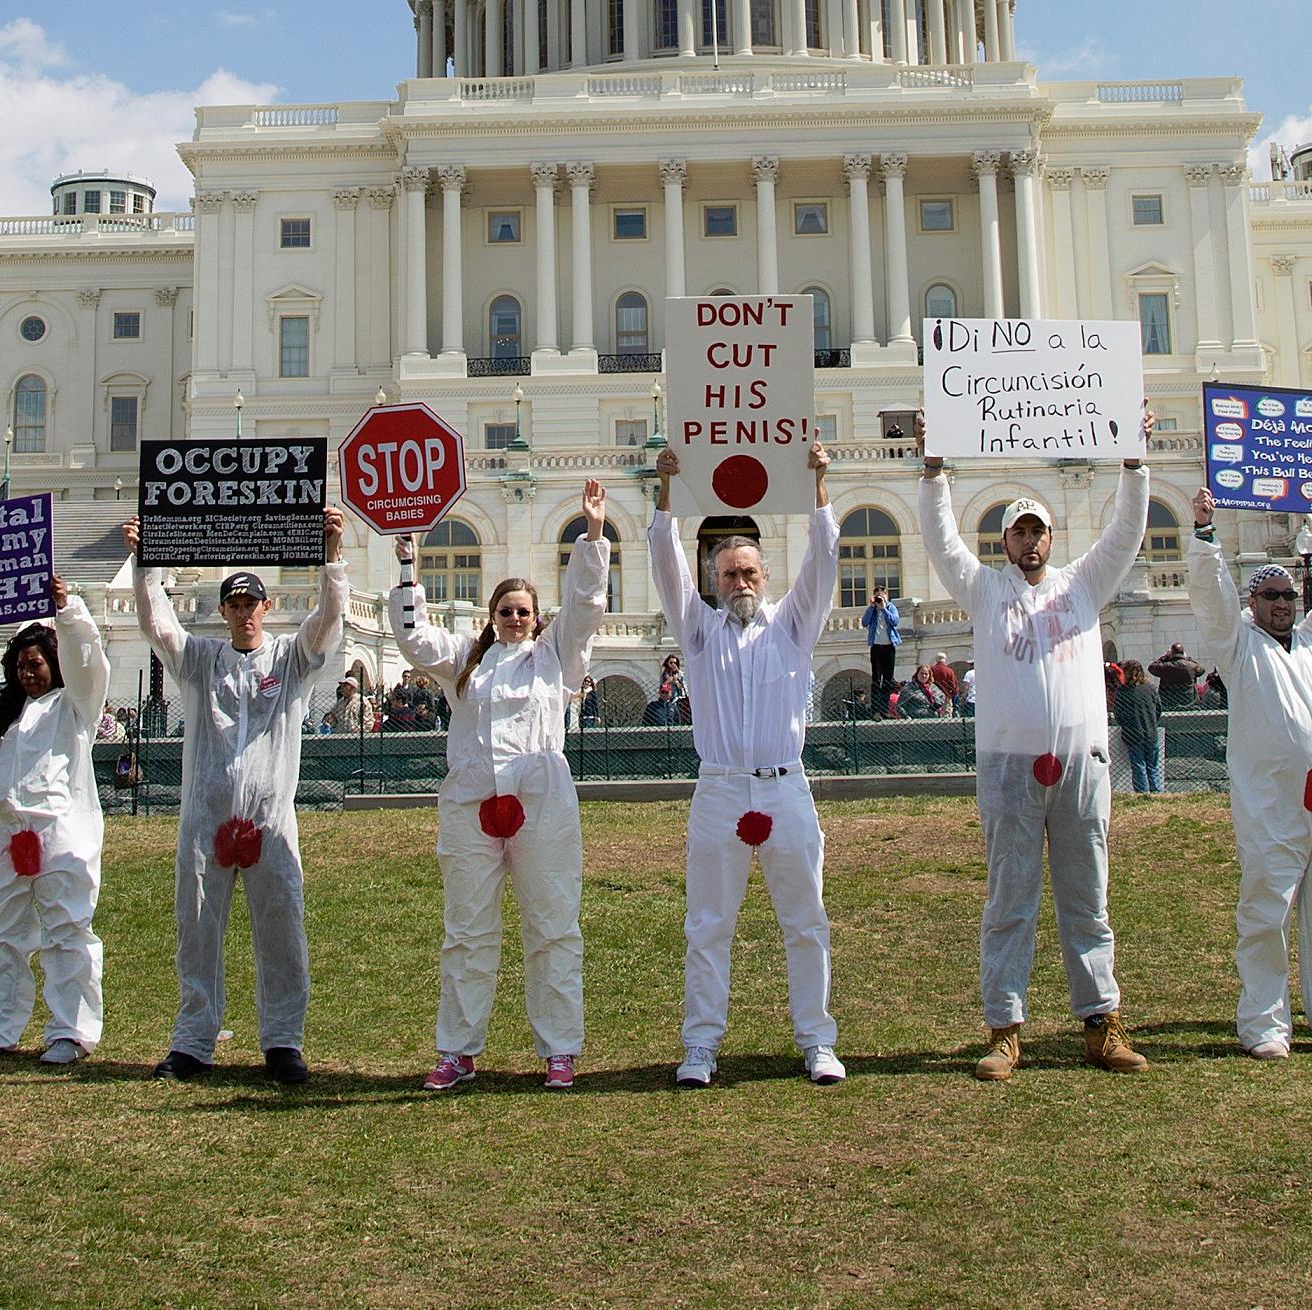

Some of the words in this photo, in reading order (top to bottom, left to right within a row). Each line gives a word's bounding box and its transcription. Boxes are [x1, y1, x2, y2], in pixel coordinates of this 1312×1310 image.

[697, 298, 793, 327] DON'T
[992, 321, 1032, 348] NO
[1048, 333, 1065, 350] a
[1081, 325, 1107, 351] la
[707, 342, 777, 369] CUT
[942, 363, 1102, 397] Circuncisión
[705, 380, 768, 409] HIS
[977, 395, 1102, 421] Rutinaria
[683, 418, 808, 445] PENIS!
[1254, 436, 1281, 447] The
[155, 446, 314, 475] OCCUPY
[357, 438, 445, 496] STOP
[1251, 449, 1294, 462] You've
[1241, 465, 1269, 475] This
[1272, 467, 1295, 478] Bull
[145, 479, 323, 505] FORESKIN
[367, 494, 442, 510] CIRCUMCISING
[386, 509, 424, 521] BABIES
